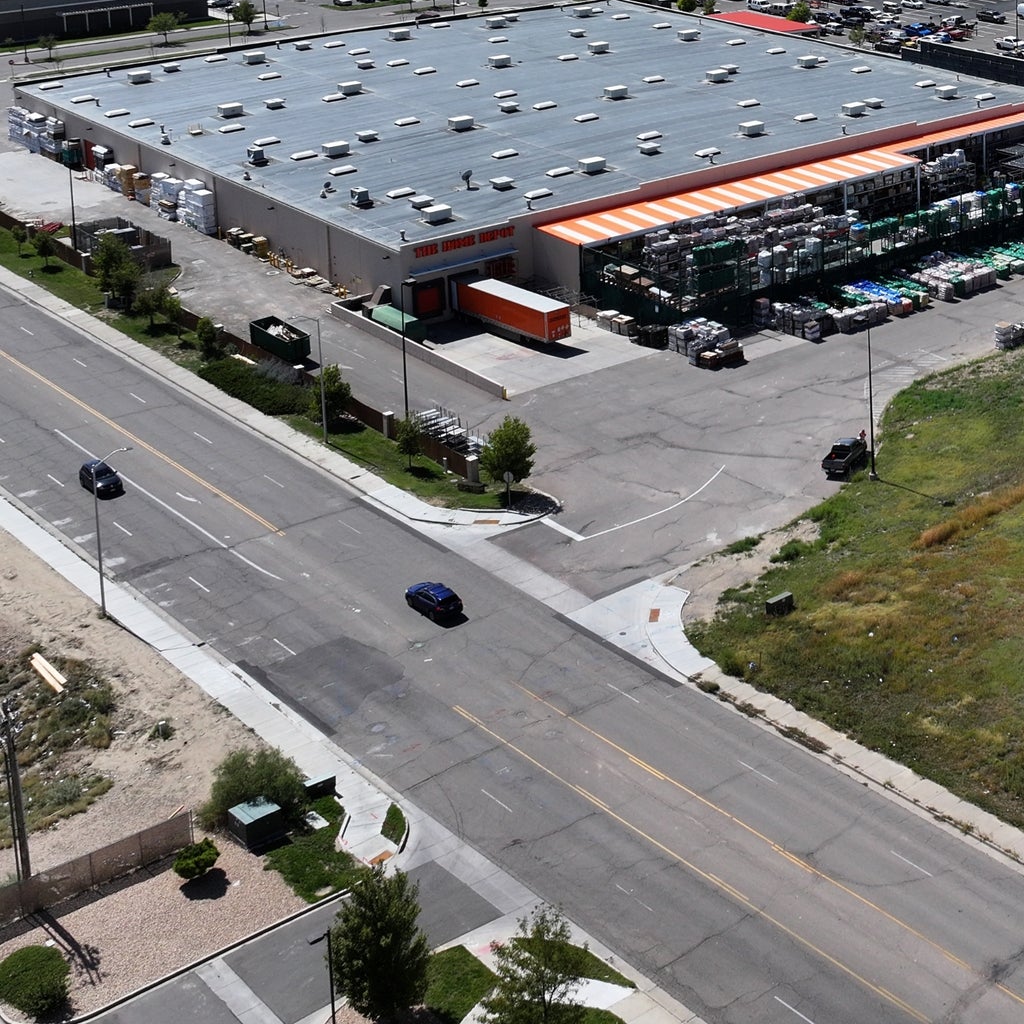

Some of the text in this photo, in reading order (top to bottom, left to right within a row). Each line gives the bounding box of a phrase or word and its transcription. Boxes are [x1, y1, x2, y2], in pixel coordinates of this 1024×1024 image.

[414, 225, 515, 258] THE HOME DEPOT
